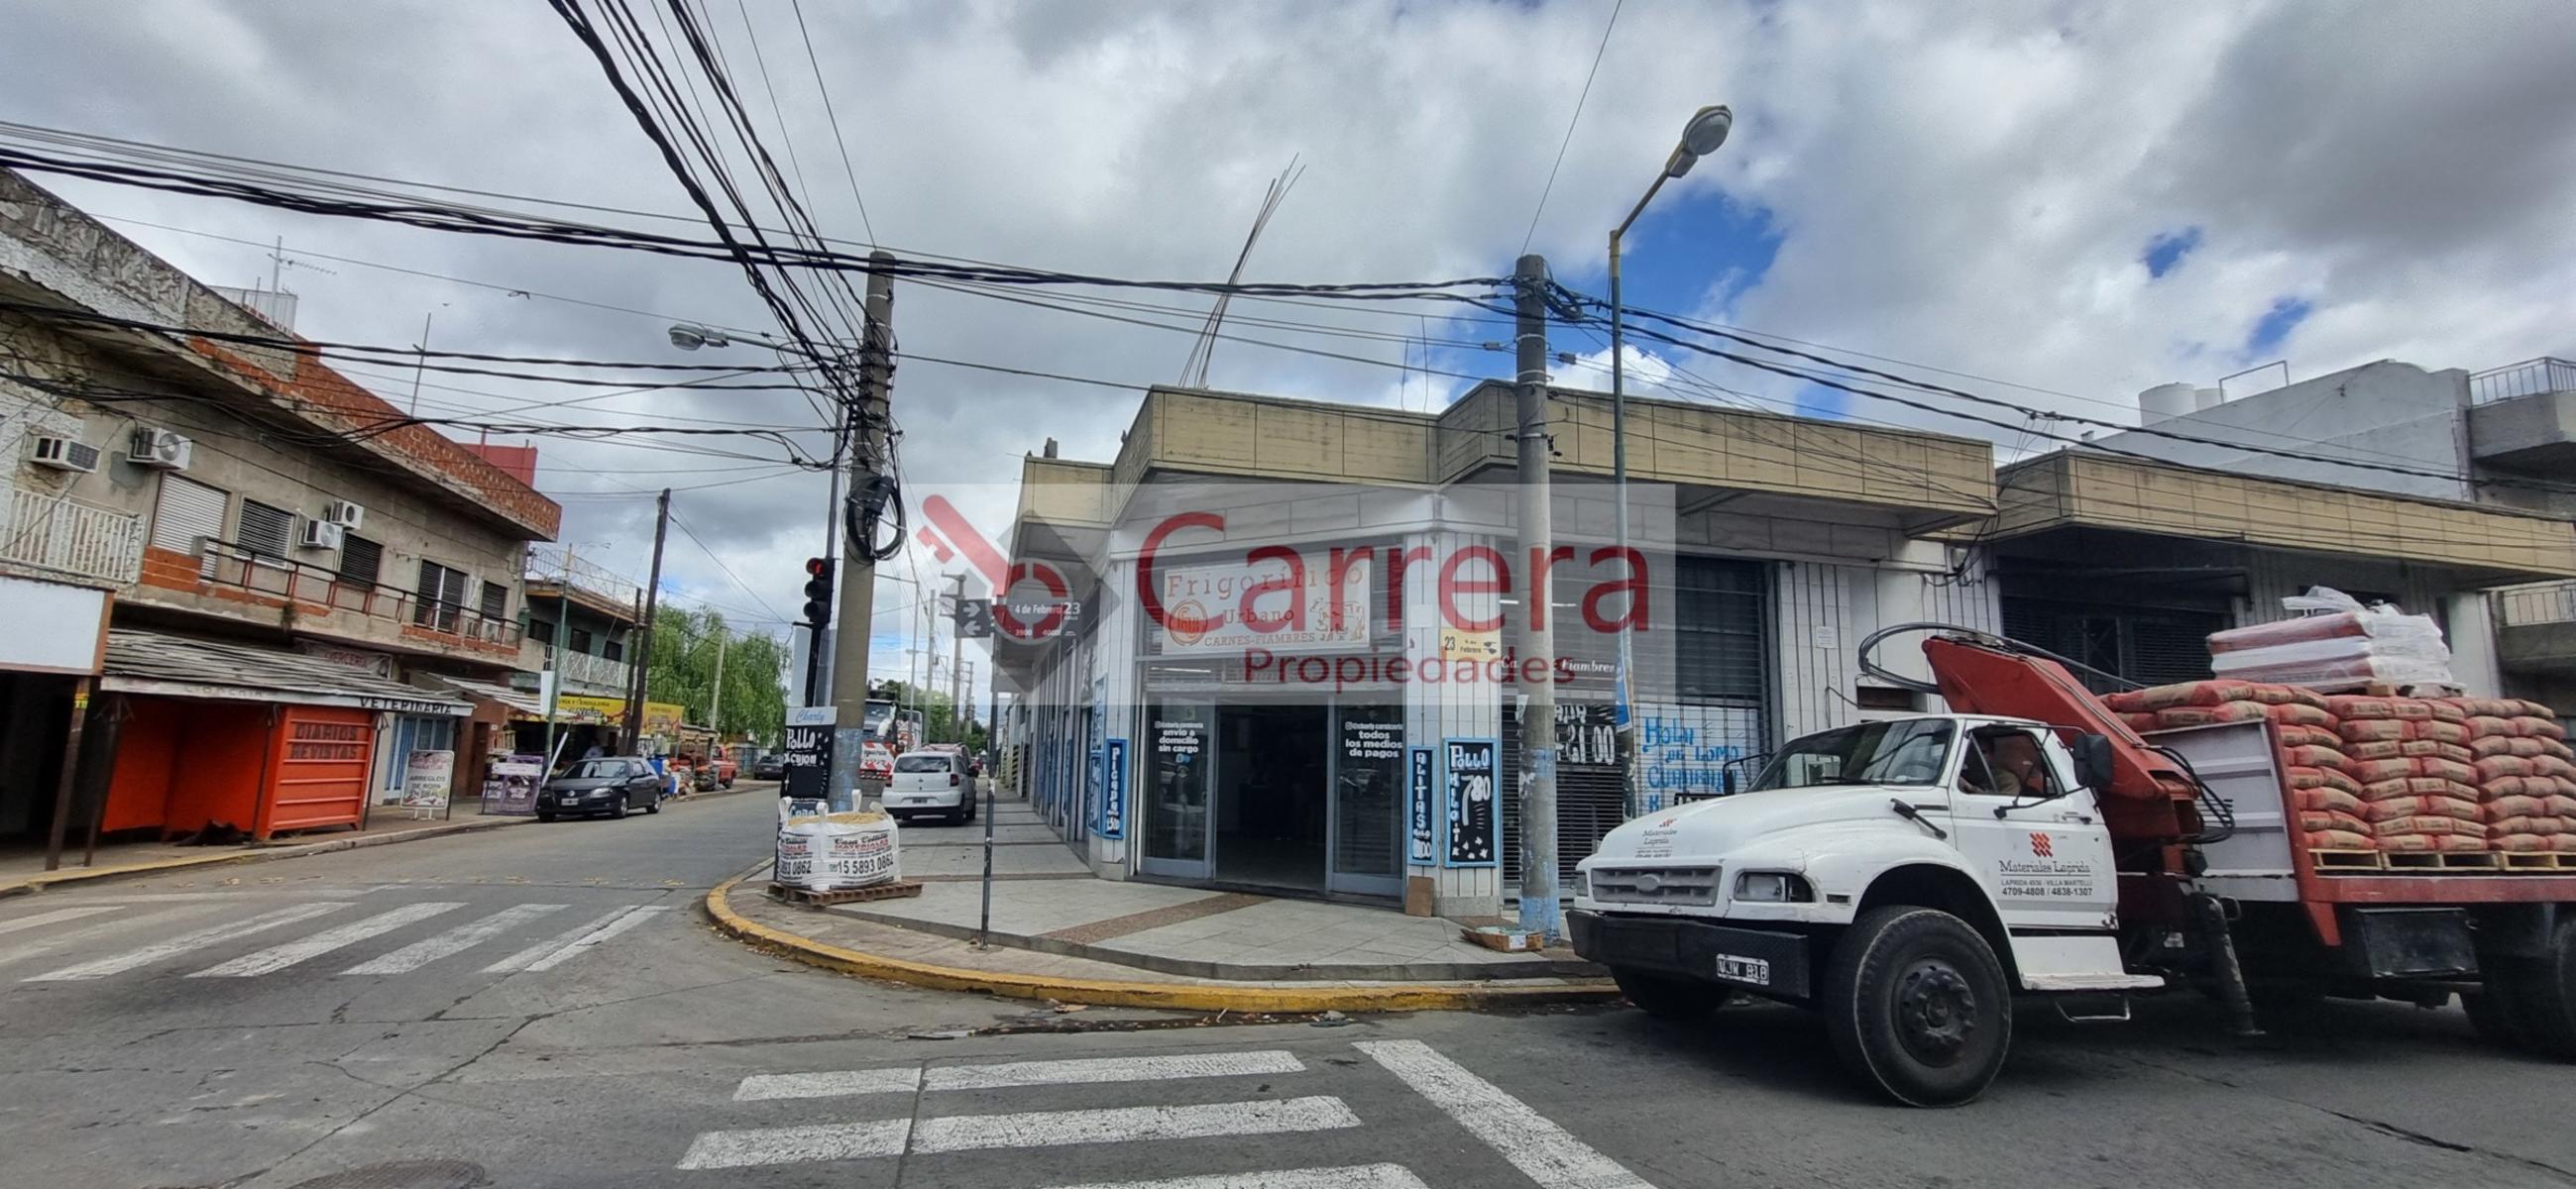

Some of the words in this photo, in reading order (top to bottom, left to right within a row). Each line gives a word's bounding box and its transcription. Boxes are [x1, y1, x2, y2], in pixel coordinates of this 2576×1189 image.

[1022, 604, 1030, 613] de
[1033, 604, 1063, 613] Febrero
[1064, 602, 1080, 614] 23
[1223, 608, 1294, 623] Urbano
[1204, 633, 1315, 646] CARNES-FIAMBRES
[1444, 636, 1456, 651] 23
[360, 698, 452, 713] VETERINARIA
[1359, 730, 1391, 739] todos
[1345, 738, 1361, 748] los
[1363, 739, 1403, 748] medios
[1349, 748, 1363, 757] de
[1365, 750, 1399, 759] pagos
[1461, 775, 1491, 826] 780
[792, 859, 812, 875] 0862
[852, 859, 875, 874] 5893
[877, 853, 893, 870] 0862
[1999, 860, 2052, 872] Materiales
[2053, 860, 2090, 876] Laprida
